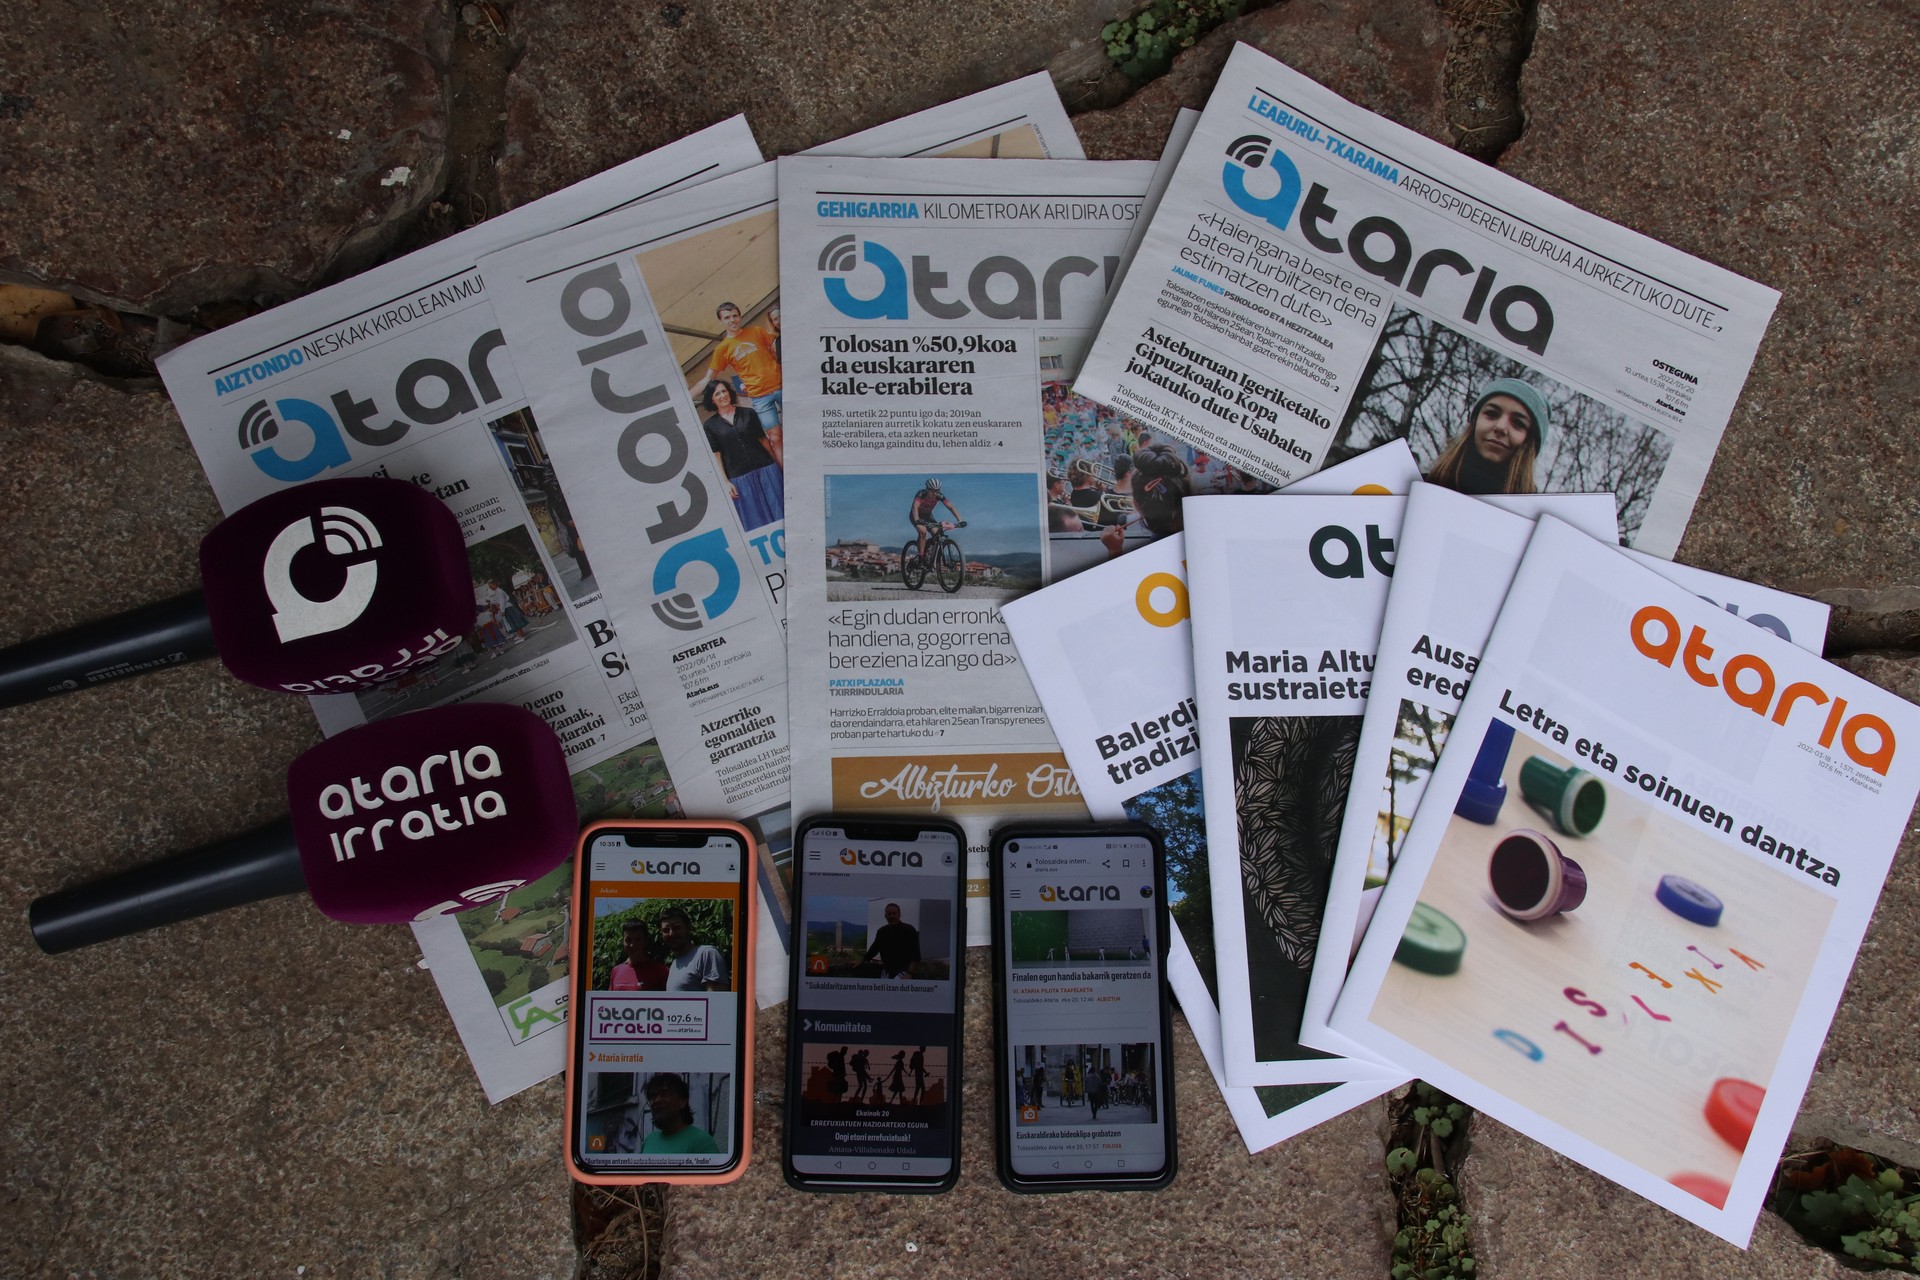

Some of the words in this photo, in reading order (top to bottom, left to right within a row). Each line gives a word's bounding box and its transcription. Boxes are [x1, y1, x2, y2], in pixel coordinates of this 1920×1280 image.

[817, 201, 919, 219] GEHIGARRIA
[924, 203, 1041, 220] KILOMETROAK
[1044, 204, 1069, 220] ARI
[1072, 204, 1110, 220] DIRA
[1247, 95, 1399, 184] LEABURU-TXARAMA
[1399, 175, 1511, 239] ARROSPIDEREN
[1509, 224, 1572, 267] LIBURUA
[1572, 256, 1673, 311] AURKEZTUKO
[1672, 298, 1716, 330] DUTE
[1222, 134, 1554, 356] ataria
[1198, 212, 1302, 269] «Haiengana
[1301, 258, 1353, 294] beste
[1354, 286, 1382, 308] era
[1180, 245, 1279, 302] estimatzen
[1280, 291, 1332, 327] dute»
[1187, 224, 1246, 265] batera
[1247, 248, 1331, 305] hurbiltzen
[1333, 294, 1377, 328] dena
[1171, 265, 1199, 284] JAUME
[1198, 277, 1225, 296] FUNES
[1223, 290, 1269, 317] PSIKOLOGO
[1284, 317, 1333, 351] HEZITZAILEA
[214, 349, 304, 396] AIZTONDO
[302, 320, 375, 361] NESKAK
[371, 287, 456, 334] KIROLEAN
[820, 335, 909, 353] Tolosan
[912, 334, 1017, 356] %50,9koa
[820, 357, 848, 374] da
[852, 357, 976, 375] euskararen
[1652, 359, 1698, 385] OSTEGUNA
[821, 376, 973, 396] kale-erabilera
[1135, 341, 1235, 401] Gipuzkoako
[1234, 389, 1279, 424] Kopa
[1142, 326, 1239, 383] Asteburuan
[1237, 374, 1331, 431] Igeriketako
[1657, 373, 1695, 394] 2022/01/20
[1116, 383, 1162, 414] Tolosaldea
[822, 409, 844, 418] 1985.
[846, 409, 877, 418] urtetik
[890, 409, 917, 420] puntu
[918, 410, 933, 420] igo
[950, 409, 981, 418] 2019an
[1124, 357, 1201, 404] jokatuko
[1200, 394, 1239, 425] dute
[1240, 413, 1313, 465] Usabalen
[822, 419, 882, 429] gaztelaniaren
[884, 419, 921, 428] aurretik
[922, 419, 953, 428] kokatu
[972, 419, 1022, 428] euskararen
[822, 430, 887, 439] kale-erabilera,
[903, 429, 931, 438] azken
[932, 429, 978, 438] neurketan
[560, 261, 741, 631] ataria
[823, 440, 859, 449] %50eko
[860, 440, 885, 450] langa
[886, 440, 925, 450] gainditu
[942, 440, 968, 448] lehen
[969, 439, 991, 448] aldiz
[1177, 424, 1229, 457] larunbatean
[828, 609, 880, 630] «Egin
[883, 608, 939, 626] dudan
[672, 637, 728, 663] ASTEARTEA
[828, 630, 914, 648] handiena,
[917, 631, 1011, 651] gogorrena
[676, 652, 716, 674] 2022/06/14
[829, 651, 919, 669] bereziena
[921, 651, 979, 672] izango
[982, 650, 1017, 667] da»
[1226, 650, 1308, 673] Maria
[829, 679, 856, 687] PATXI
[857, 678, 904, 687] PLAZAOLA
[829, 687, 904, 697] TXIRRINDULARIA
[1630, 606, 1896, 776] ataria
[534, 690, 564, 709] euro
[700, 705, 761, 736] Atzerriko
[830, 708, 867, 717] Harrizko
[867, 707, 905, 716] Erraldoia
[905, 707, 939, 719] proban,
[939, 706, 958, 715] elite
[958, 705, 989, 716] mailan,
[989, 704, 1025, 716] bigarren
[1025, 705, 1044, 713] izan
[842, 717, 905, 728] orendaindarra,
[921, 716, 952, 726] hilaren
[951, 715, 980, 726] 25ean
[981, 715, 1046, 727] Transpyrenees
[704, 715, 776, 750] egonaldien
[830, 729, 862, 741] proban
[862, 729, 887, 740] parte
[887, 728, 921, 738] hartuko
[709, 730, 777, 764] garrantzia
[715, 757, 758, 778] Tolosaldea
[719, 764, 765, 787] Integratuan
[1797, 741, 1831, 763] 2022-03-18
[1855, 770, 1883, 788] zenbakia
[319, 745, 502, 820] ataria
[723, 772, 777, 796] ikastetxerekin
[860, 763, 1017, 813] Albizturko
[1498, 689, 1569, 745] Letra
[1574, 737, 1619, 773] eta
[1623, 764, 1734, 834] soinuen
[1740, 825, 1842, 887] dantza
[1850, 776, 1880, 794] Ataria.eus
[330, 790, 507, 862] irratia
[631, 859, 700, 875] ataria
[840, 848, 922, 868] ataria
[1039, 885, 1120, 902] ataria
[857, 983, 874, 991] harra
[874, 983, 886, 991] beti
[886, 984, 900, 992] izan
[900, 984, 911, 992] dut
[1012, 972, 1038, 981] Finalen
[1039, 973, 1056, 983] egun
[1057, 972, 1081, 981] handia
[1082, 972, 1111, 981] bakarrik
[1111, 971, 1141, 982] geratzen
[597, 1005, 664, 1021] ataria
[667, 1014, 691, 1023] 107.6
[600, 1023, 662, 1034] irratia
[814, 1021, 872, 1033] Komunitatea
[598, 1053, 619, 1063] Ataria
[620, 1053, 644, 1063] irratia
[810, 1119, 862, 1128] ERREFUXIATUEN
[862, 1121, 906, 1129] NAZIOARTEKO
[907, 1121, 929, 1129] EGUNA
[1016, 1132, 1060, 1140] Euskaraldirako
[1060, 1131, 1091, 1140] bideoklipa
[1092, 1130, 1122, 1140] grabatzen
[835, 1133, 850, 1142] Ongi
[850, 1133, 867, 1141] etorri
[867, 1134, 911, 1143] errefuxiatuak!
[828, 1146, 895, 1154] Amasa-Villabonako
